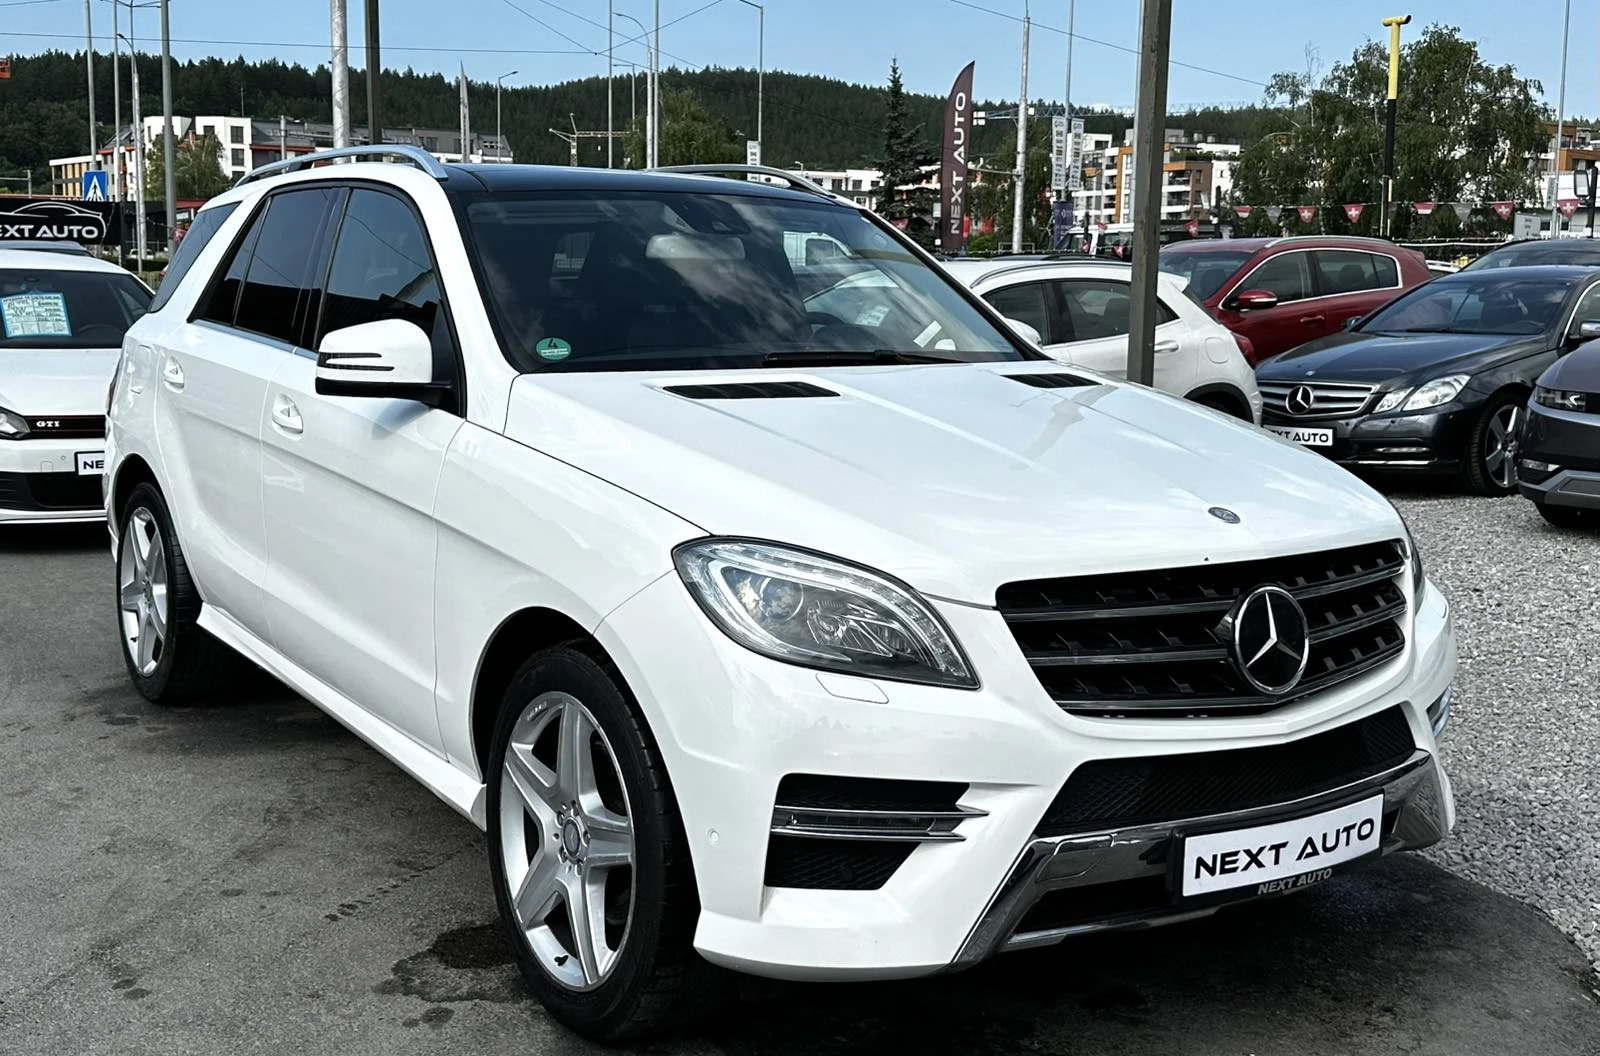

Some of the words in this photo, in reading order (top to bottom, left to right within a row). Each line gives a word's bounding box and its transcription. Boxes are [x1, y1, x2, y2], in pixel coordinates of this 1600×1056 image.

[953, 92, 966, 165] AUTO
[951, 171, 964, 234] NEXT
[0, 224, 34, 238] XT
[35, 224, 99, 239] AUTO
[36, 420, 60, 428] GTI
[1292, 432, 1329, 443] AUTO
[83, 460, 104, 470] NE
[1194, 841, 1289, 879] NEXT
[1296, 818, 1375, 861] AUTO
[1257, 877, 1295, 896] NEXT
[1296, 868, 1332, 887] AUTO
